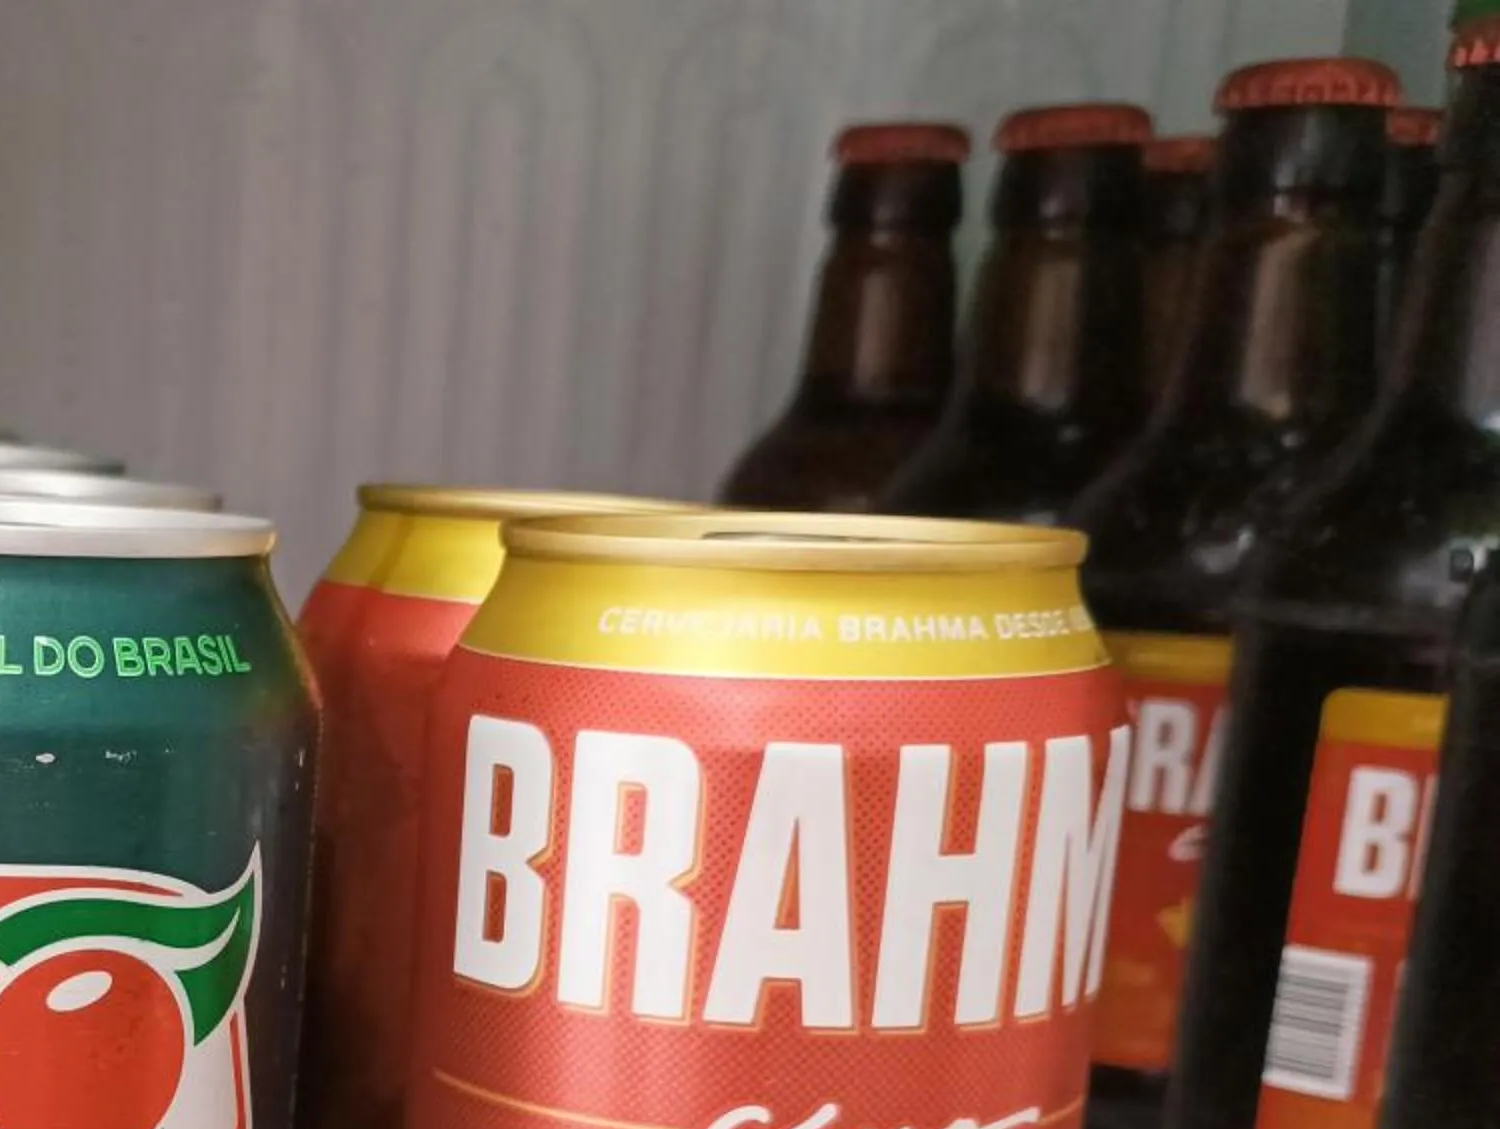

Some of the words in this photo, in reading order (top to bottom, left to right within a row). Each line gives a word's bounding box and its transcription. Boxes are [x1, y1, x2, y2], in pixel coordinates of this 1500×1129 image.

[838, 612, 989, 643] BRAHMA
[995, 608, 1070, 640] DESDE
[33, 634, 105, 679] DO
[112, 634, 252, 678] BRASIL
